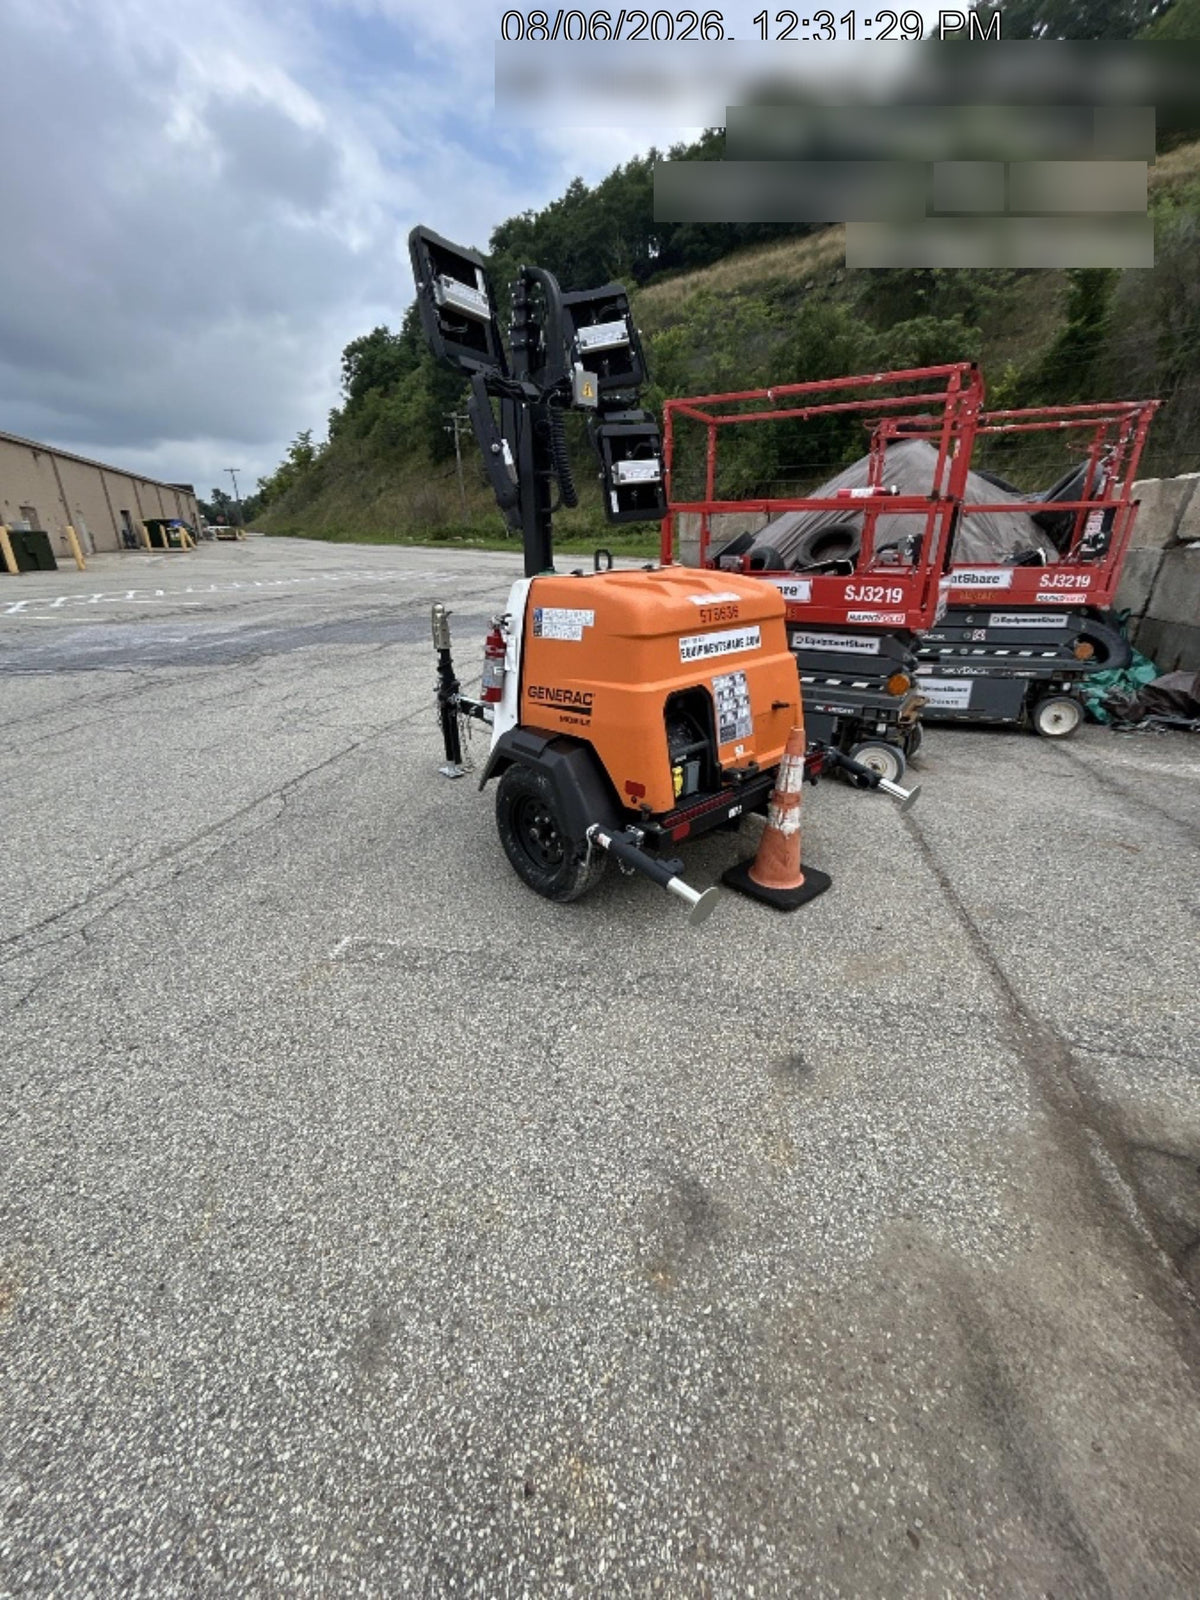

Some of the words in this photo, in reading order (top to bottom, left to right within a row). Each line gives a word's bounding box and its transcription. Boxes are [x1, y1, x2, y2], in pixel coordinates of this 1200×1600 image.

[951, 573, 1000, 585] ntShare
[1039, 573, 1091, 588] SJ3219
[844, 584, 904, 604] SJ3219
[680, 635, 760, 659] EQUIPMENTSHARE.COM
[804, 635, 875, 650] EquipmentShare
[527, 685, 594, 706] GENERAC
